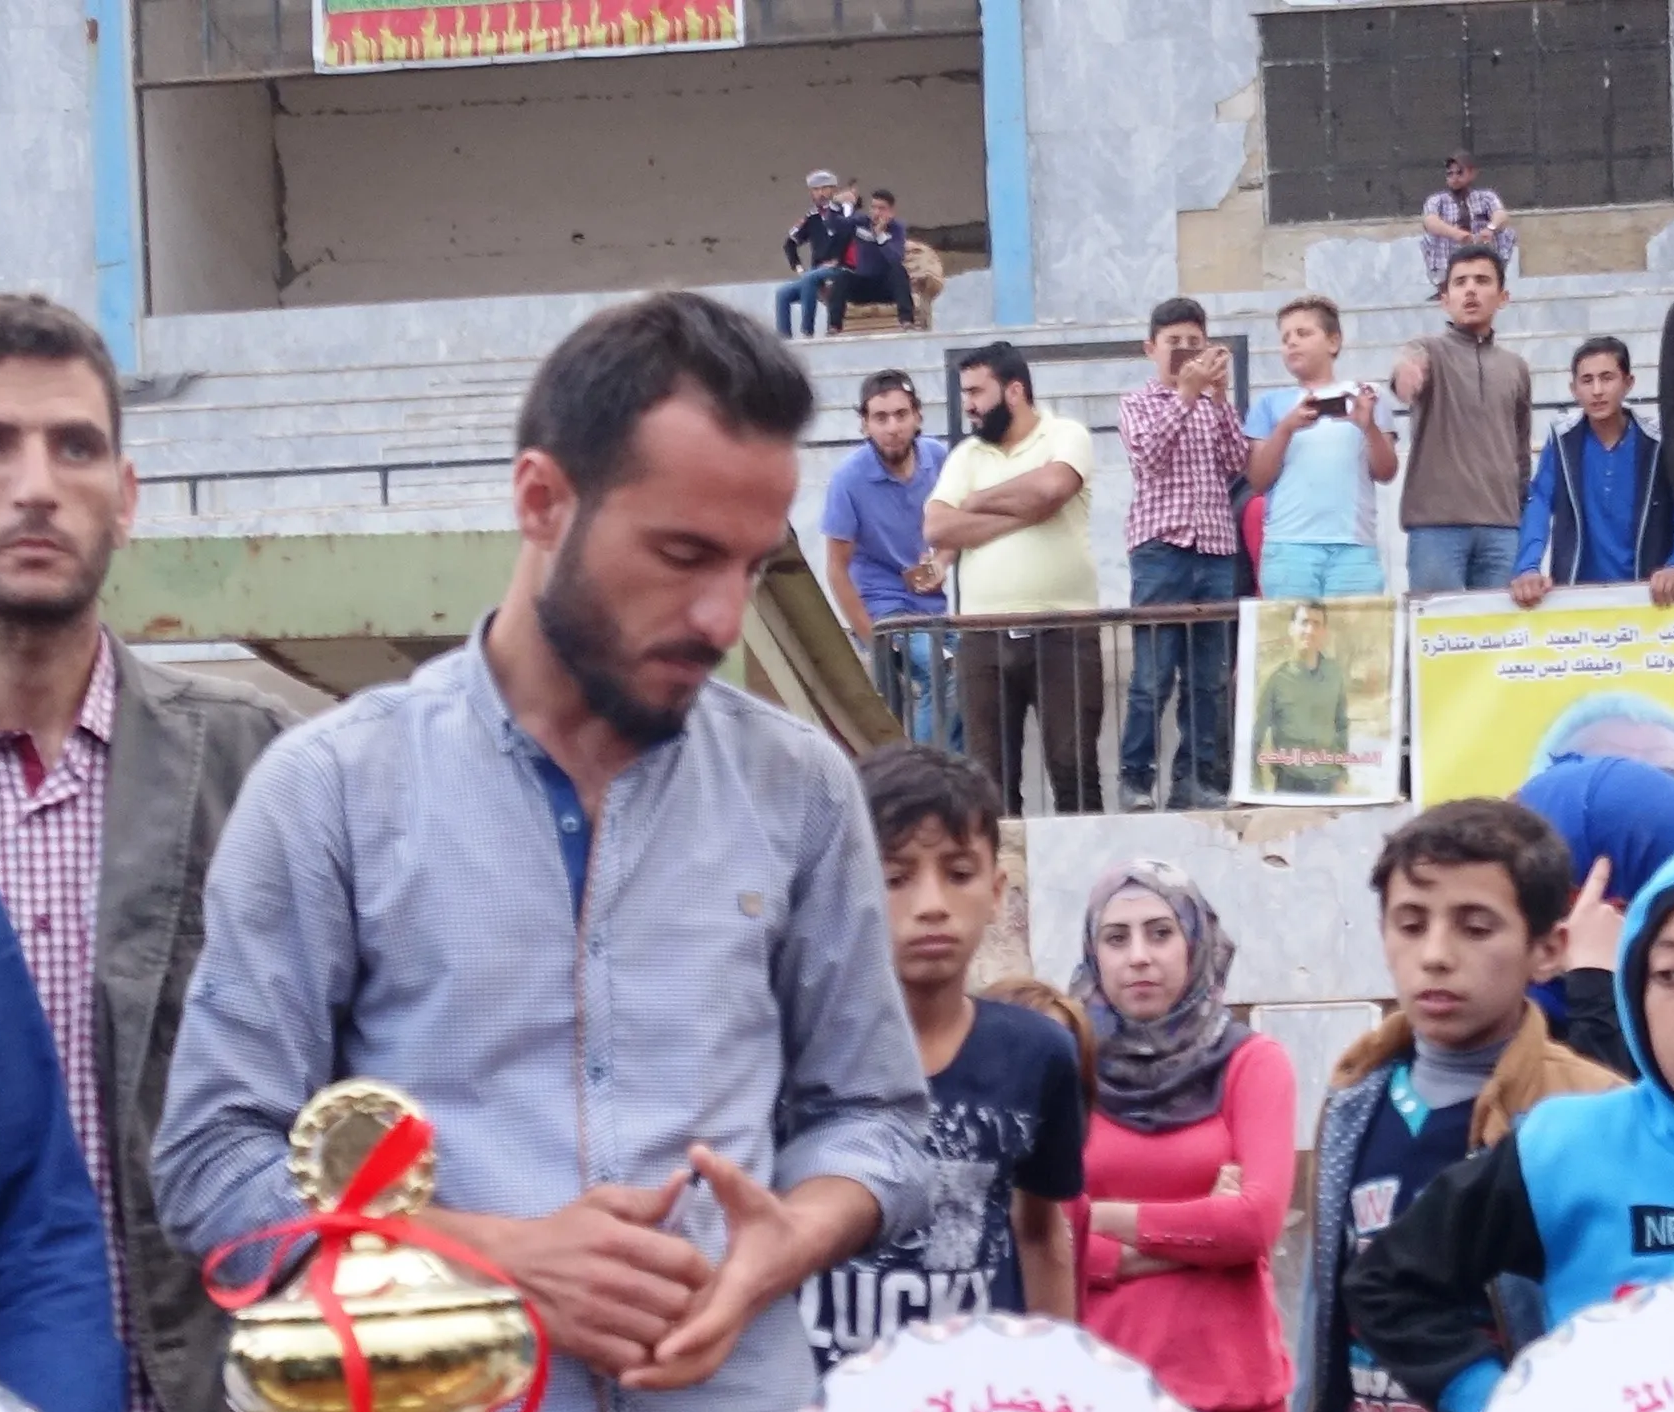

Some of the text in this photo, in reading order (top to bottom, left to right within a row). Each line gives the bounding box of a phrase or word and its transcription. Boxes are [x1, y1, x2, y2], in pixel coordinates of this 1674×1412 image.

[1421, 634, 1476, 657] متناثرة
[1545, 631, 1588, 650] البعيد
[1592, 627, 1638, 648] القريب
[1539, 659, 1568, 678] ليس
